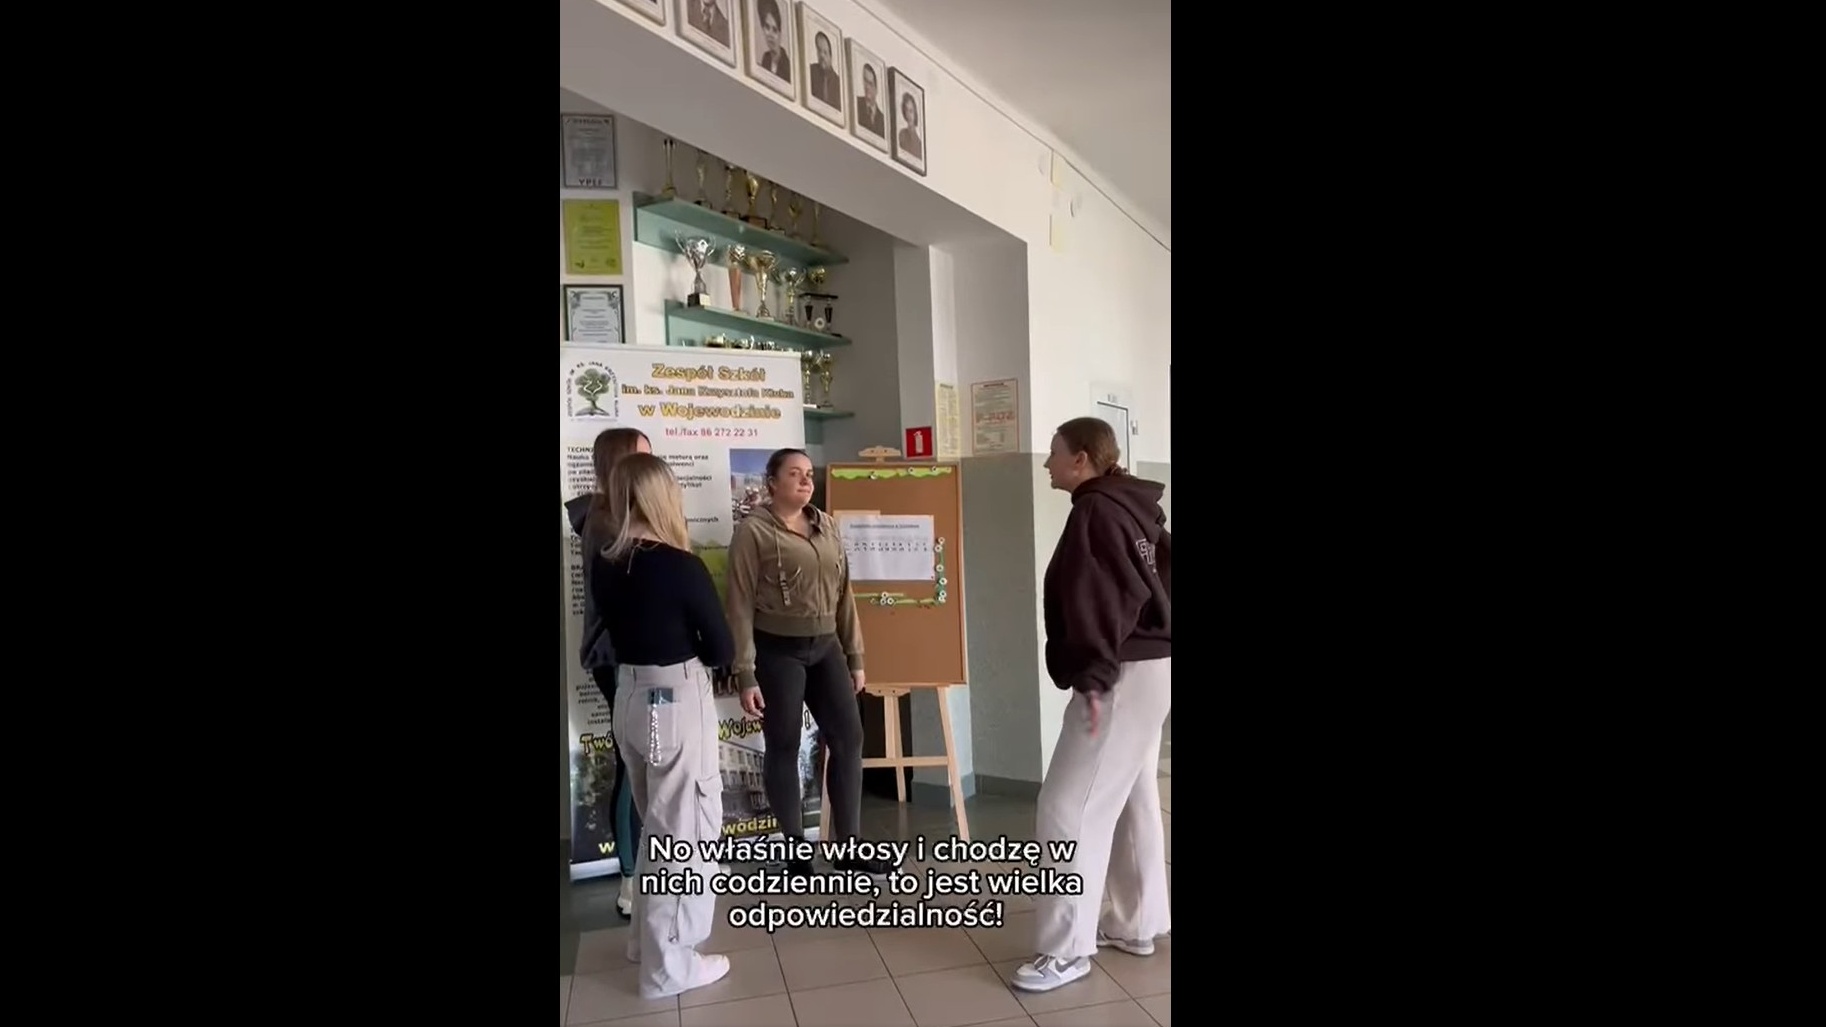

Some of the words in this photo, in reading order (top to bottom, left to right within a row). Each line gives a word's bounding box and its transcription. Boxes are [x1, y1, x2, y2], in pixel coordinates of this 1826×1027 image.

[652, 363, 714, 381] Zespół
[718, 366, 766, 381] Szkół
[622, 384, 641, 395] im.
[638, 404, 656, 416] w
[659, 402, 781, 419] Wojewodzinie
[715, 428, 731, 437] 272
[734, 429, 745, 437] 22
[580, 731, 614, 753] Twó
[718, 716, 763, 740] Wojew
